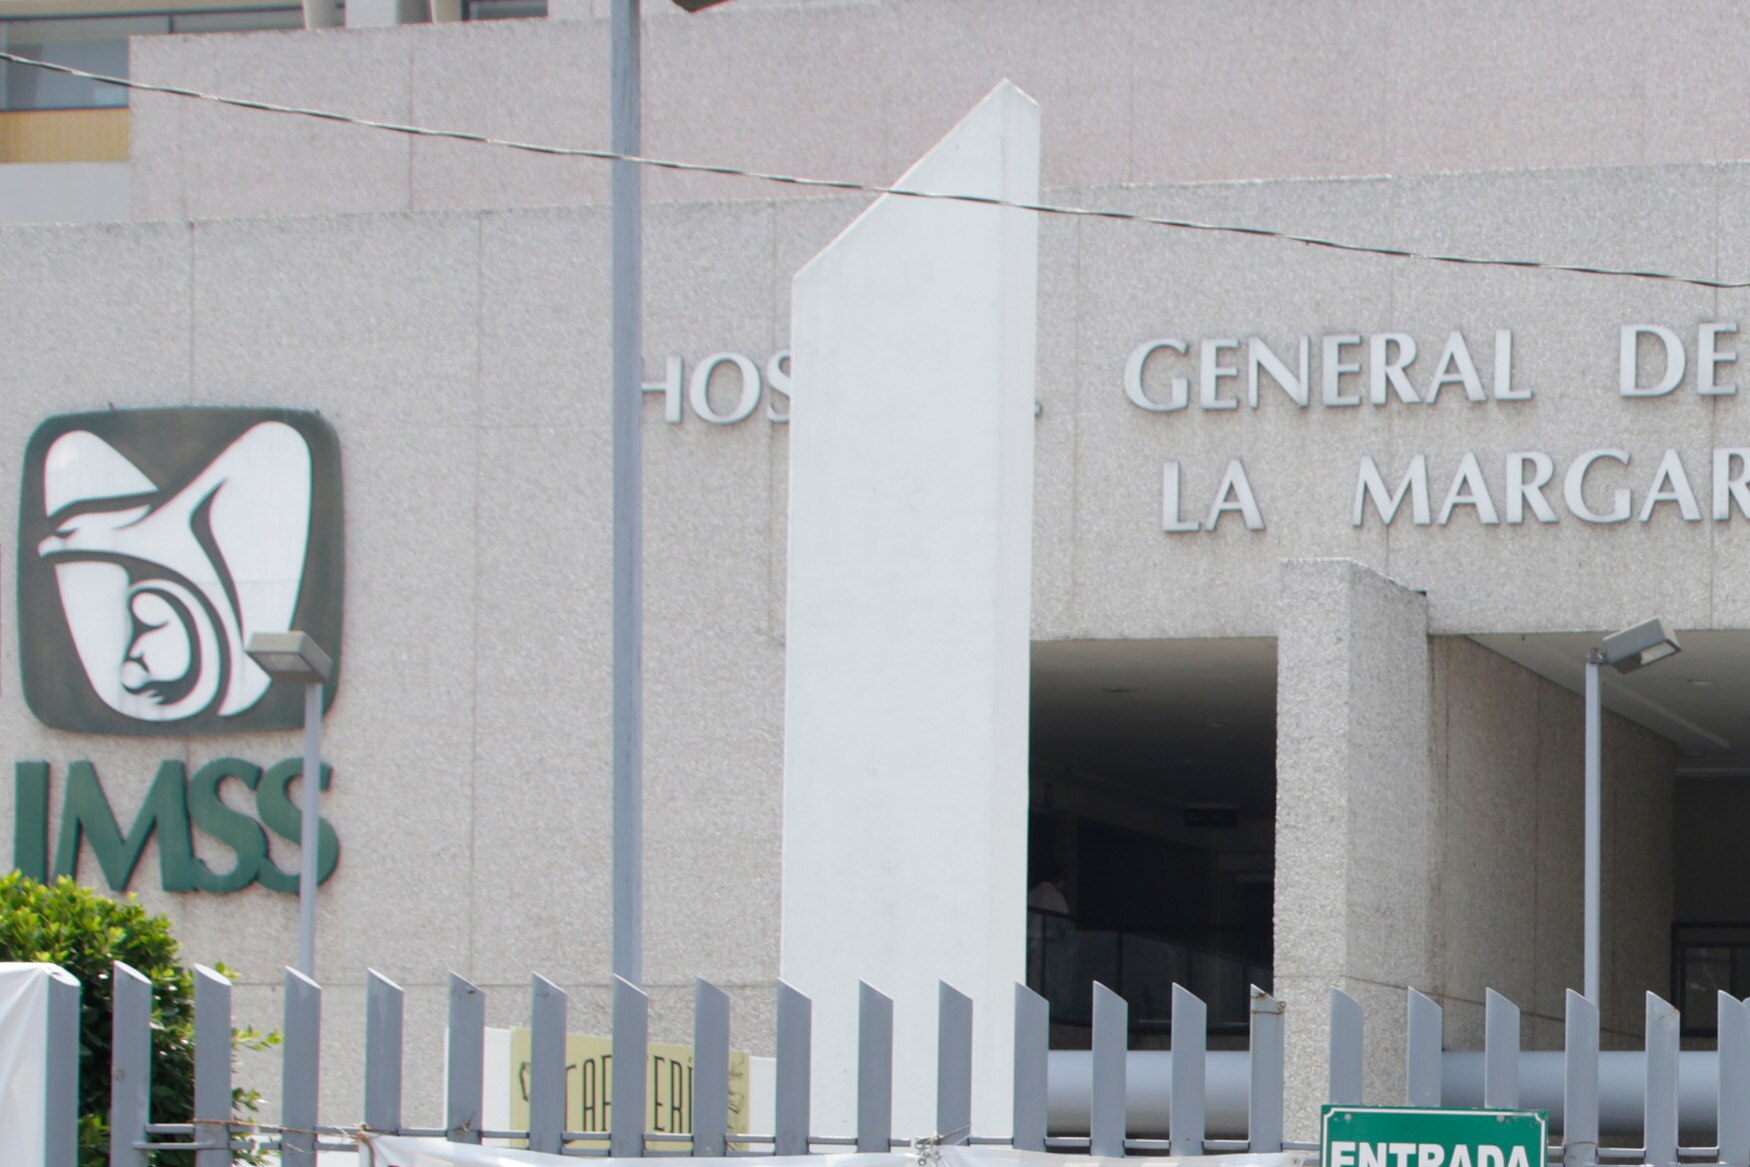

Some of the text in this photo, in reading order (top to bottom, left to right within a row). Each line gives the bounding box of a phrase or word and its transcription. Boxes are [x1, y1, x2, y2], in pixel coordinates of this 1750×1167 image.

[1123, 329, 1534, 413] GENERAL
[1620, 322, 1738, 398] DE
[1162, 458, 1266, 533] LA
[14, 756, 340, 894] IMSS
